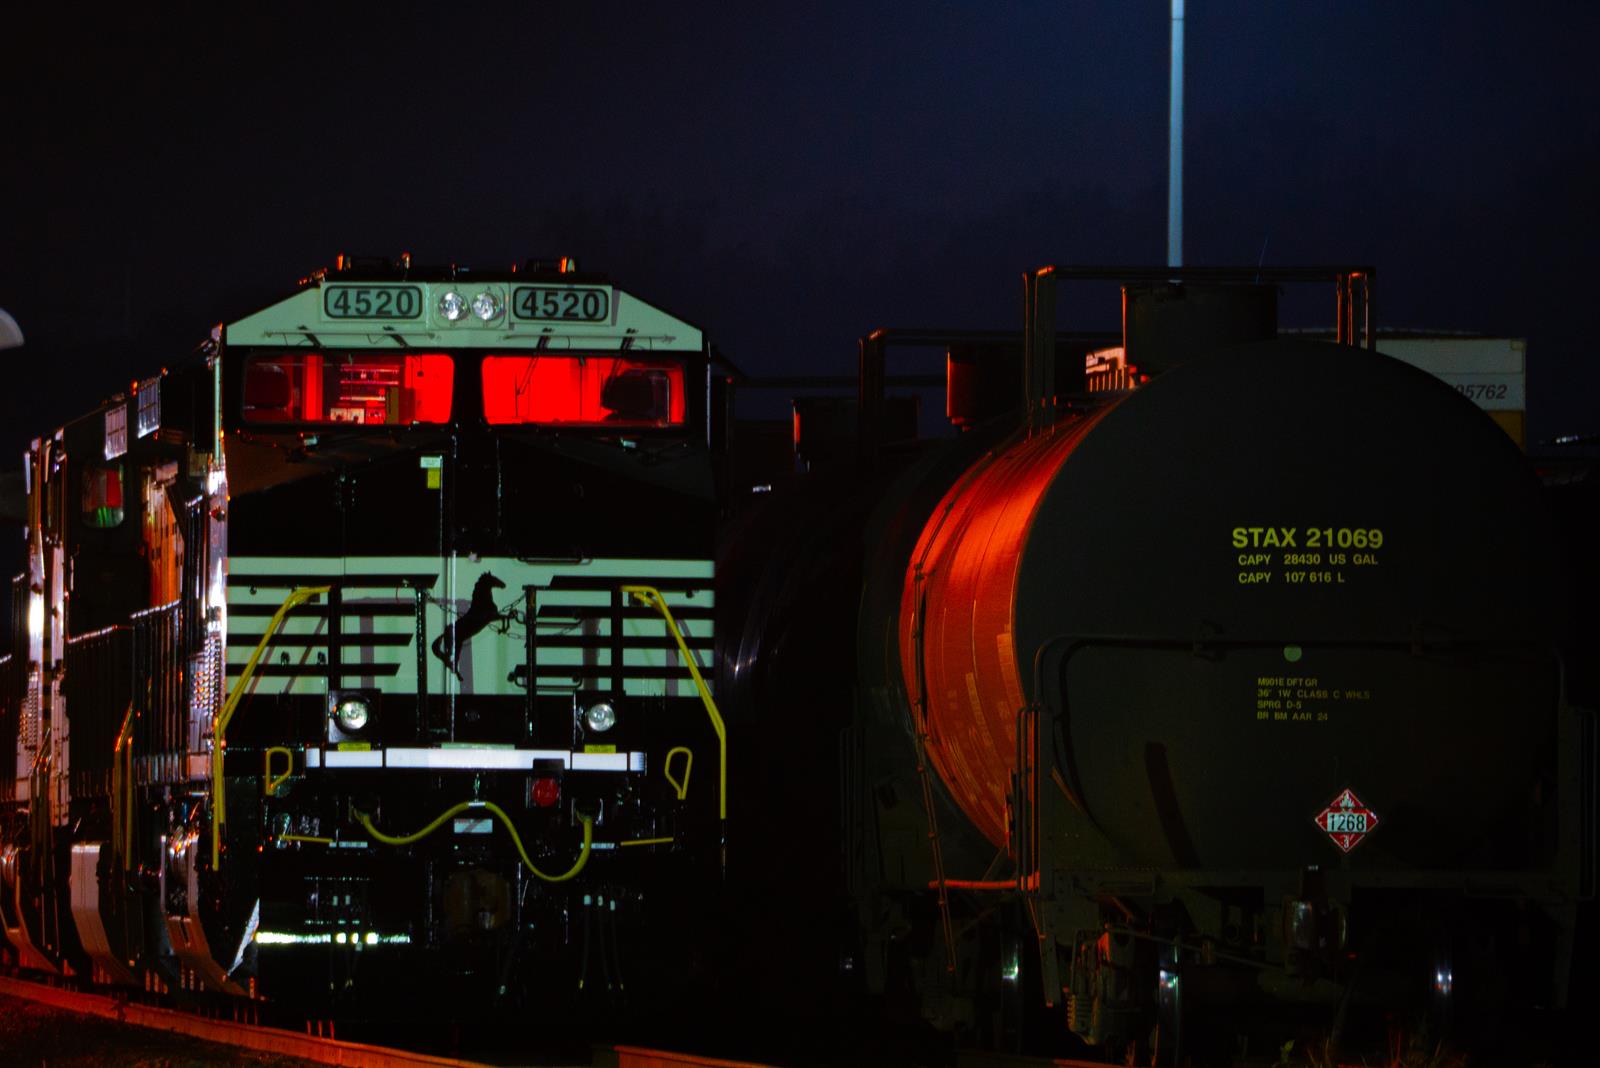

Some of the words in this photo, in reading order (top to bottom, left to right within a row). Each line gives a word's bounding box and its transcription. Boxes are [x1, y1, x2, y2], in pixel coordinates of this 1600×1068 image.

[334, 290, 413, 315] 4520
[522, 292, 599, 317] 4520
[1232, 527, 1296, 548] STAX
[1305, 527, 1384, 548] 21069
[1238, 553, 1272, 566] CAPY
[1283, 553, 1321, 566] 28430
[1328, 553, 1346, 566] US
[1353, 553, 1378, 566] GAL
[1238, 571, 1272, 584] CAPY
[1337, 571, 1345, 584] L
[1296, 690, 1328, 699] CLASS
[1333, 690, 1340, 699] C
[1292, 712, 1312, 720] AAR
[1317, 712, 1329, 721] 24
[1330, 814, 1365, 832] 1268
